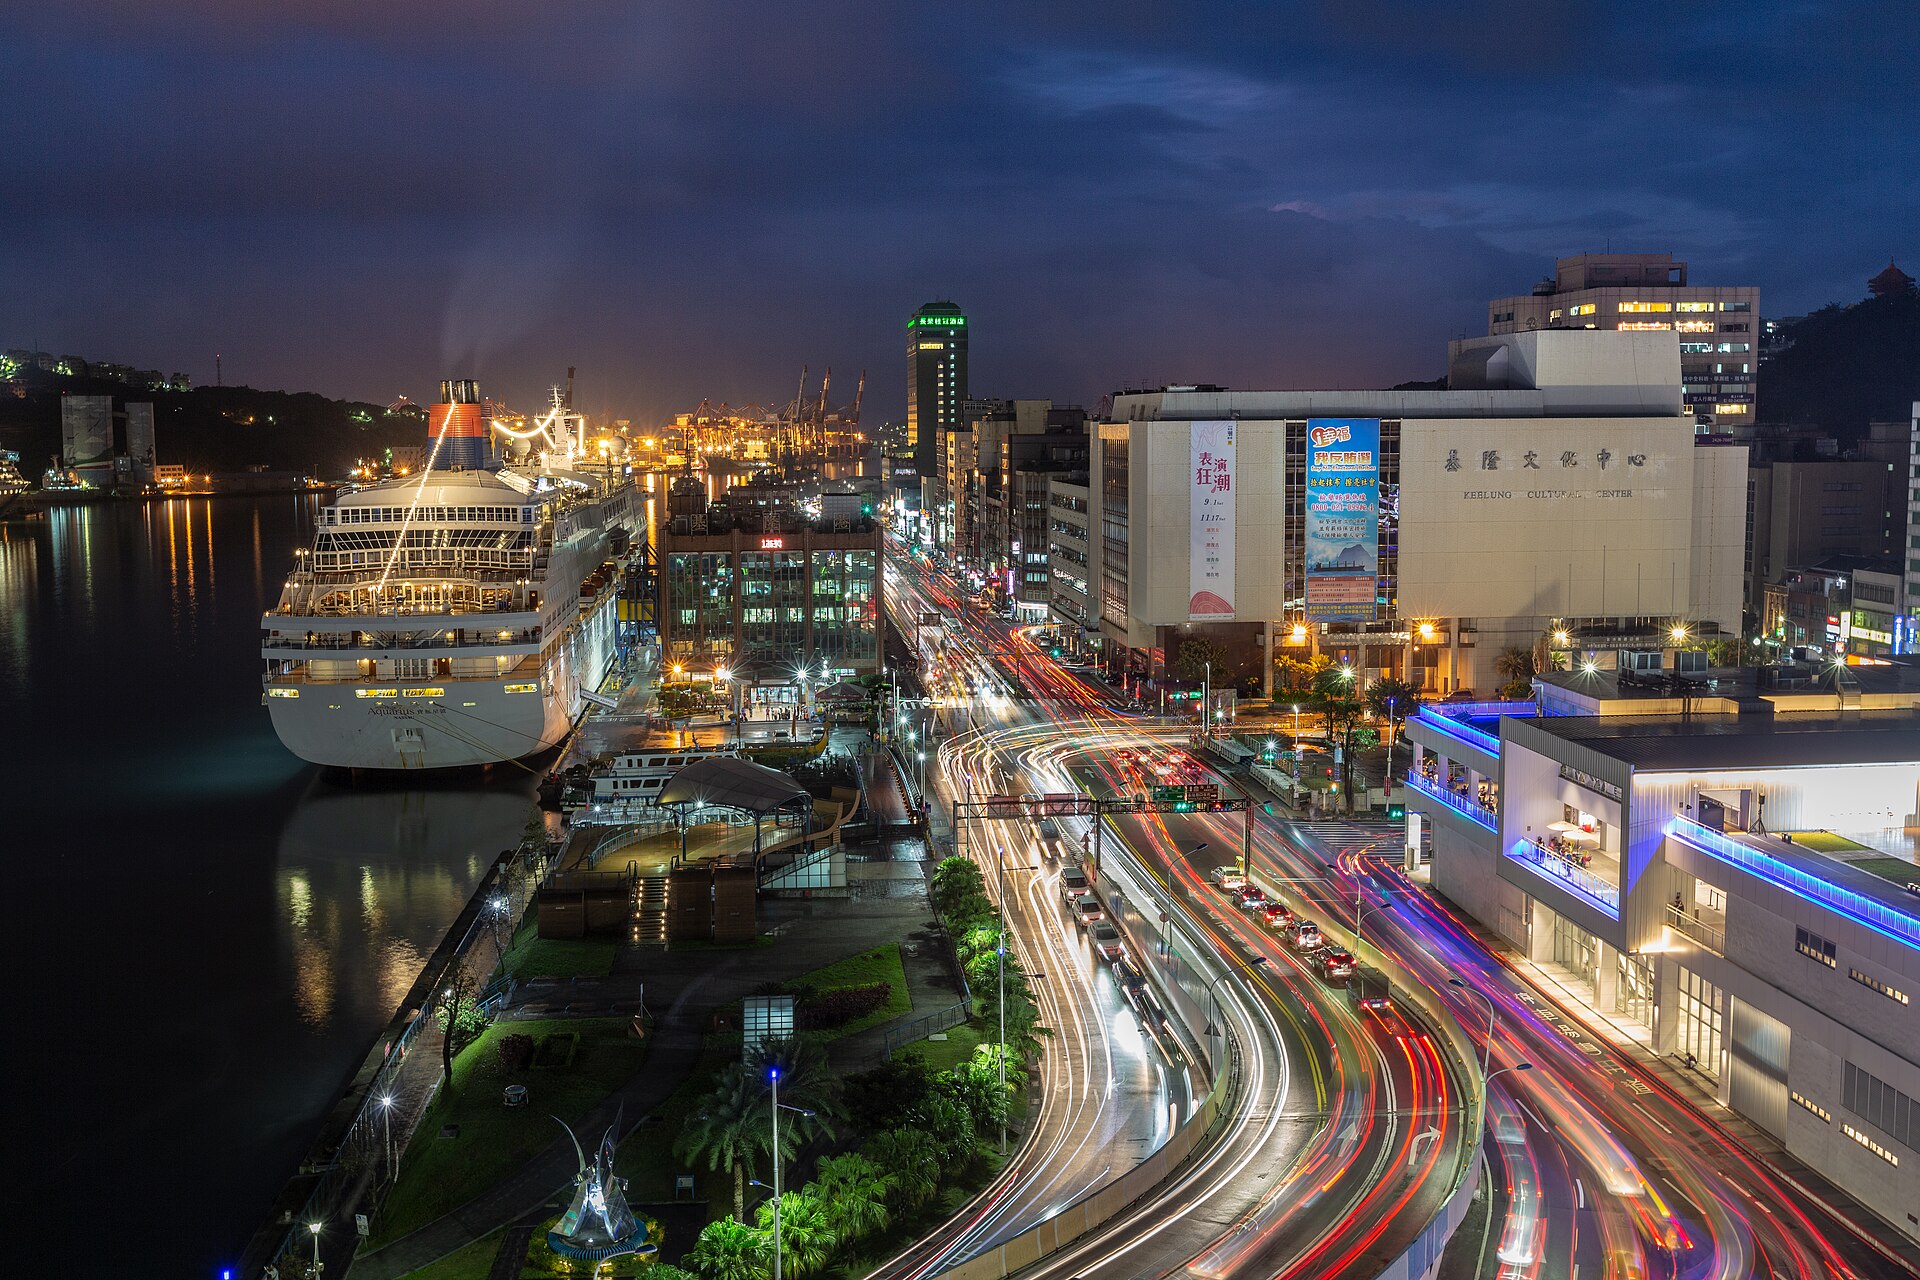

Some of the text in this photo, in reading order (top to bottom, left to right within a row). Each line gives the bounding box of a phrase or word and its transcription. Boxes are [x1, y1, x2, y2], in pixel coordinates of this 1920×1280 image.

[1314, 452, 1371, 465] 我反賄選
[1445, 449, 1646, 471] 基隆文化中心
[1463, 489, 1633, 499] KEELUNG CULTURAL CENTER
[368, 707, 415, 716] Aquarius
